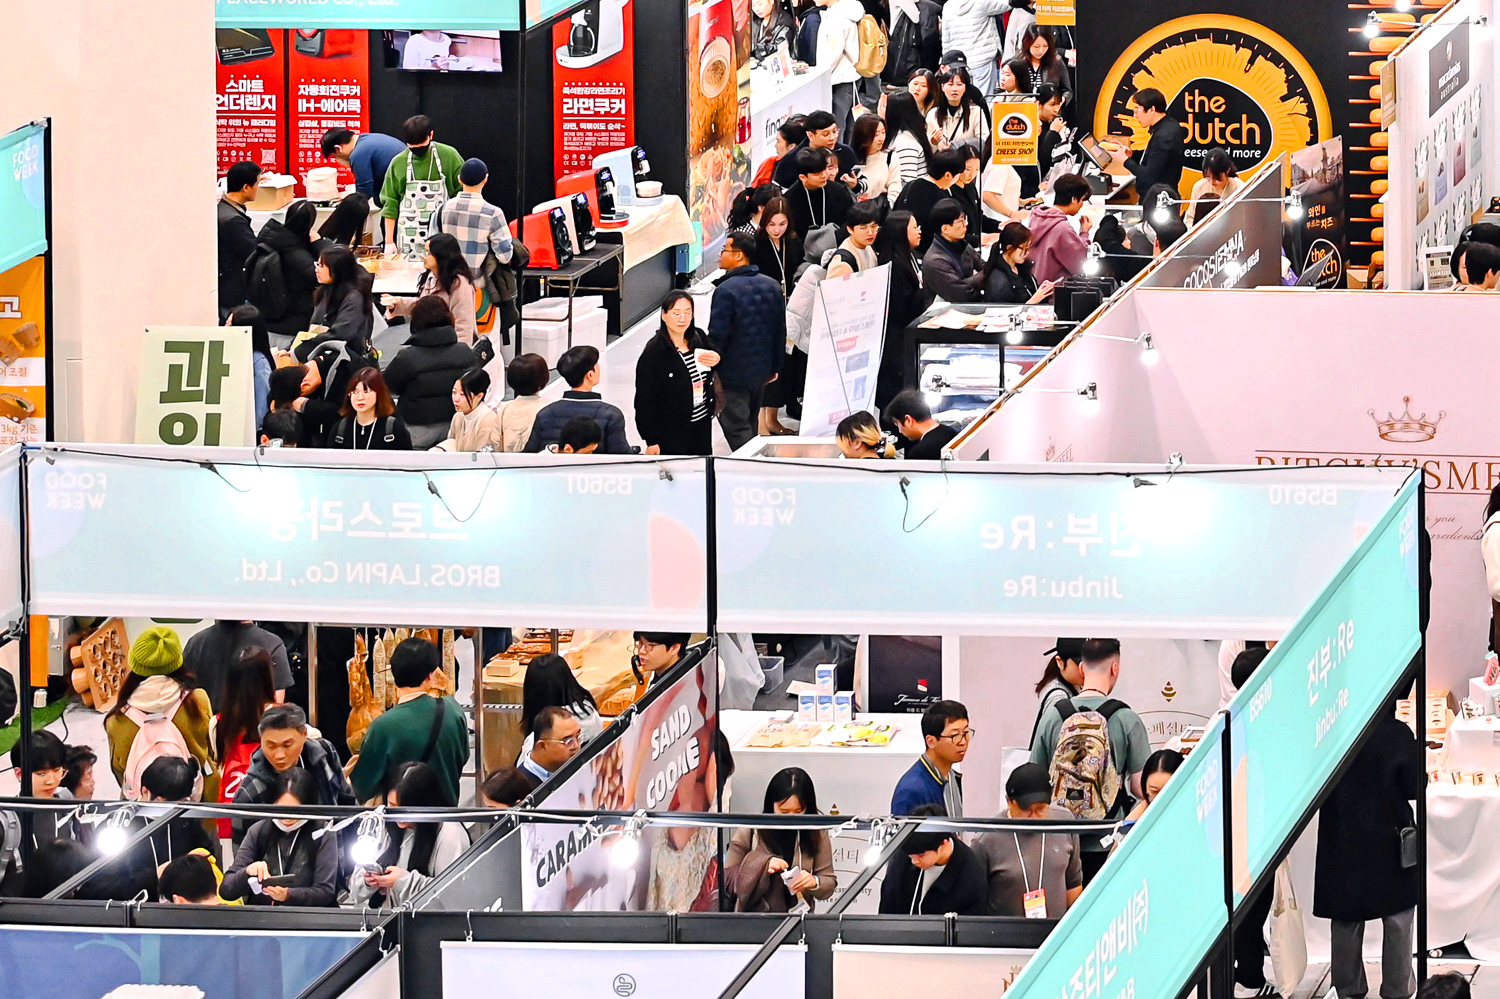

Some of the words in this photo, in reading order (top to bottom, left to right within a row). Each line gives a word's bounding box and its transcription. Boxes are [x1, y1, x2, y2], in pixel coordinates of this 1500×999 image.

[225, 79, 264, 93] 스마트
[562, 97, 626, 115] 라면쿠커
[1184, 88, 1227, 113] the
[12, 143, 39, 167] FOOD
[996, 148, 1017, 156] CHEESE
[1018, 147, 1035, 155] SHOP
[1232, 149, 1262, 158] more
[1306, 619, 1355, 708] 진부:Re
[1313, 686, 1349, 748] Jinbu:Re
[651, 704, 692, 761] SAND
